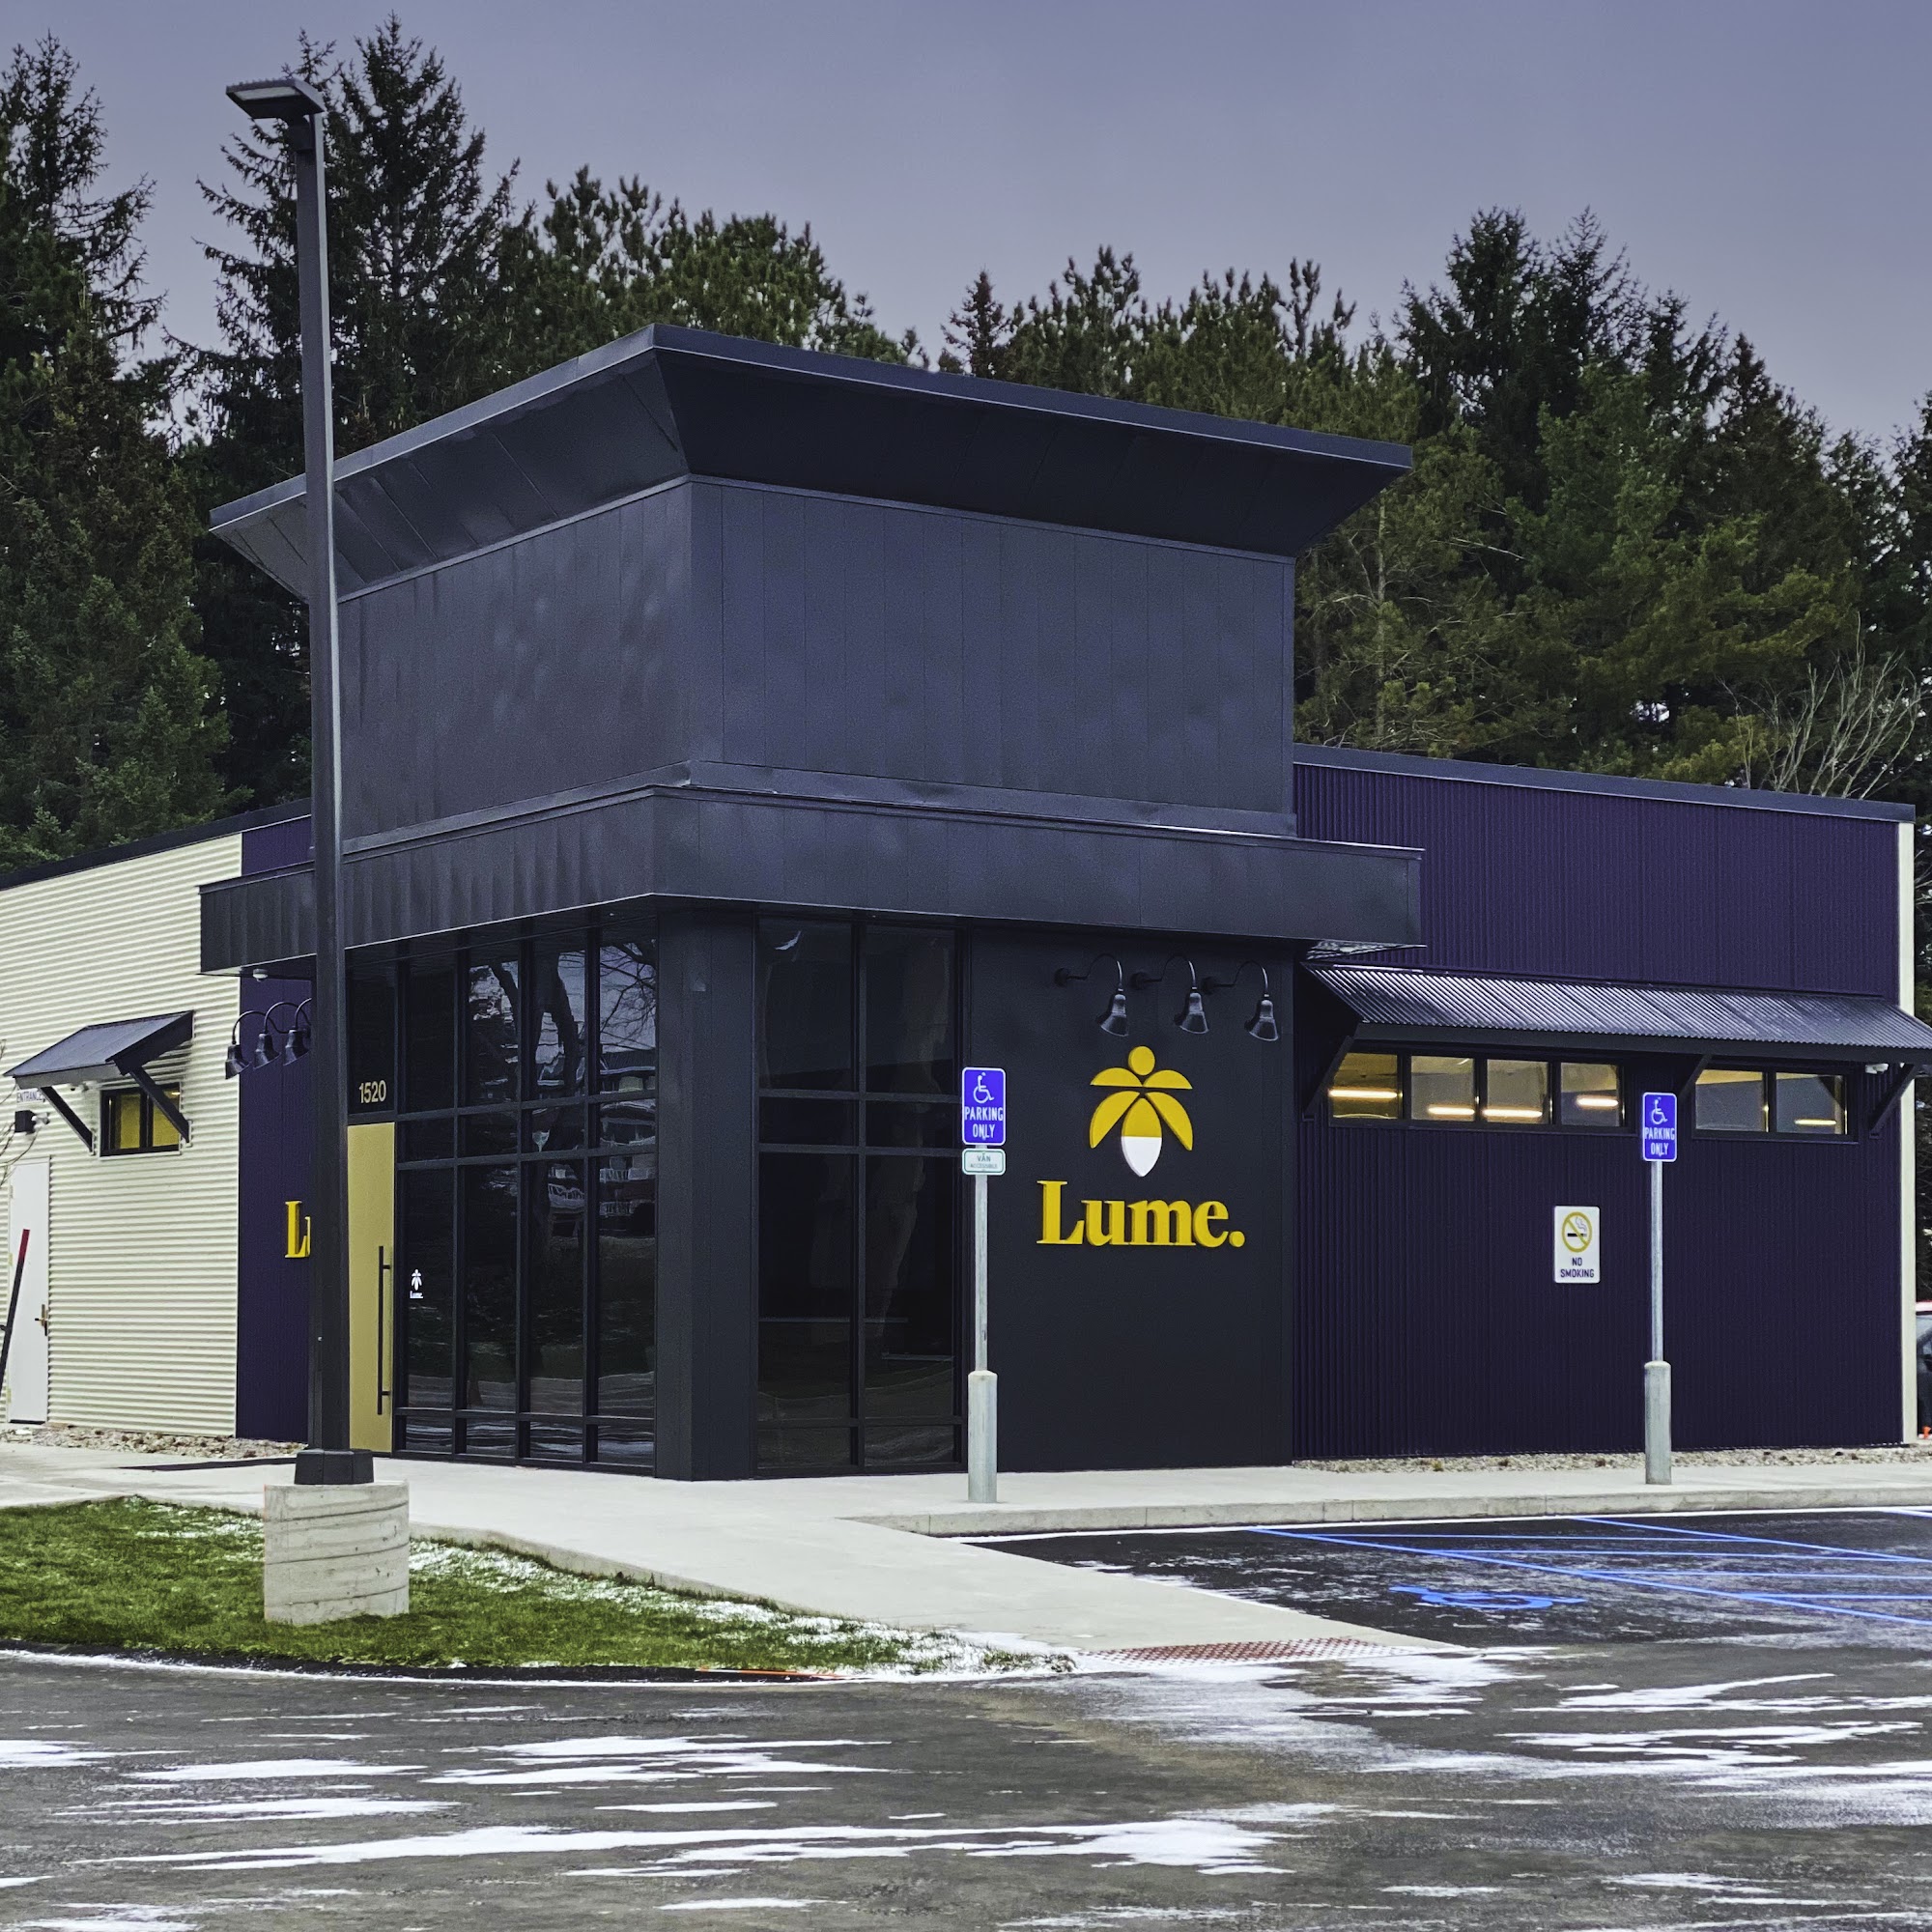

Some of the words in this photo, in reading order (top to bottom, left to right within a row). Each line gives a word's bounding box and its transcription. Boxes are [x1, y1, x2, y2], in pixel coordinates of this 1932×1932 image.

[358, 1079, 386, 1103] 1520
[964, 1106, 1004, 1122] PARKING
[972, 1123, 995, 1138] ONLY
[1644, 1126, 1675, 1141] PARKING
[1650, 1142, 1669, 1156] ONLY
[1037, 1180, 1245, 1248] Lume.
[284, 1200, 311, 1259] L
[1572, 1257, 1582, 1266] NO
[1560, 1268, 1595, 1278] SMOKING
